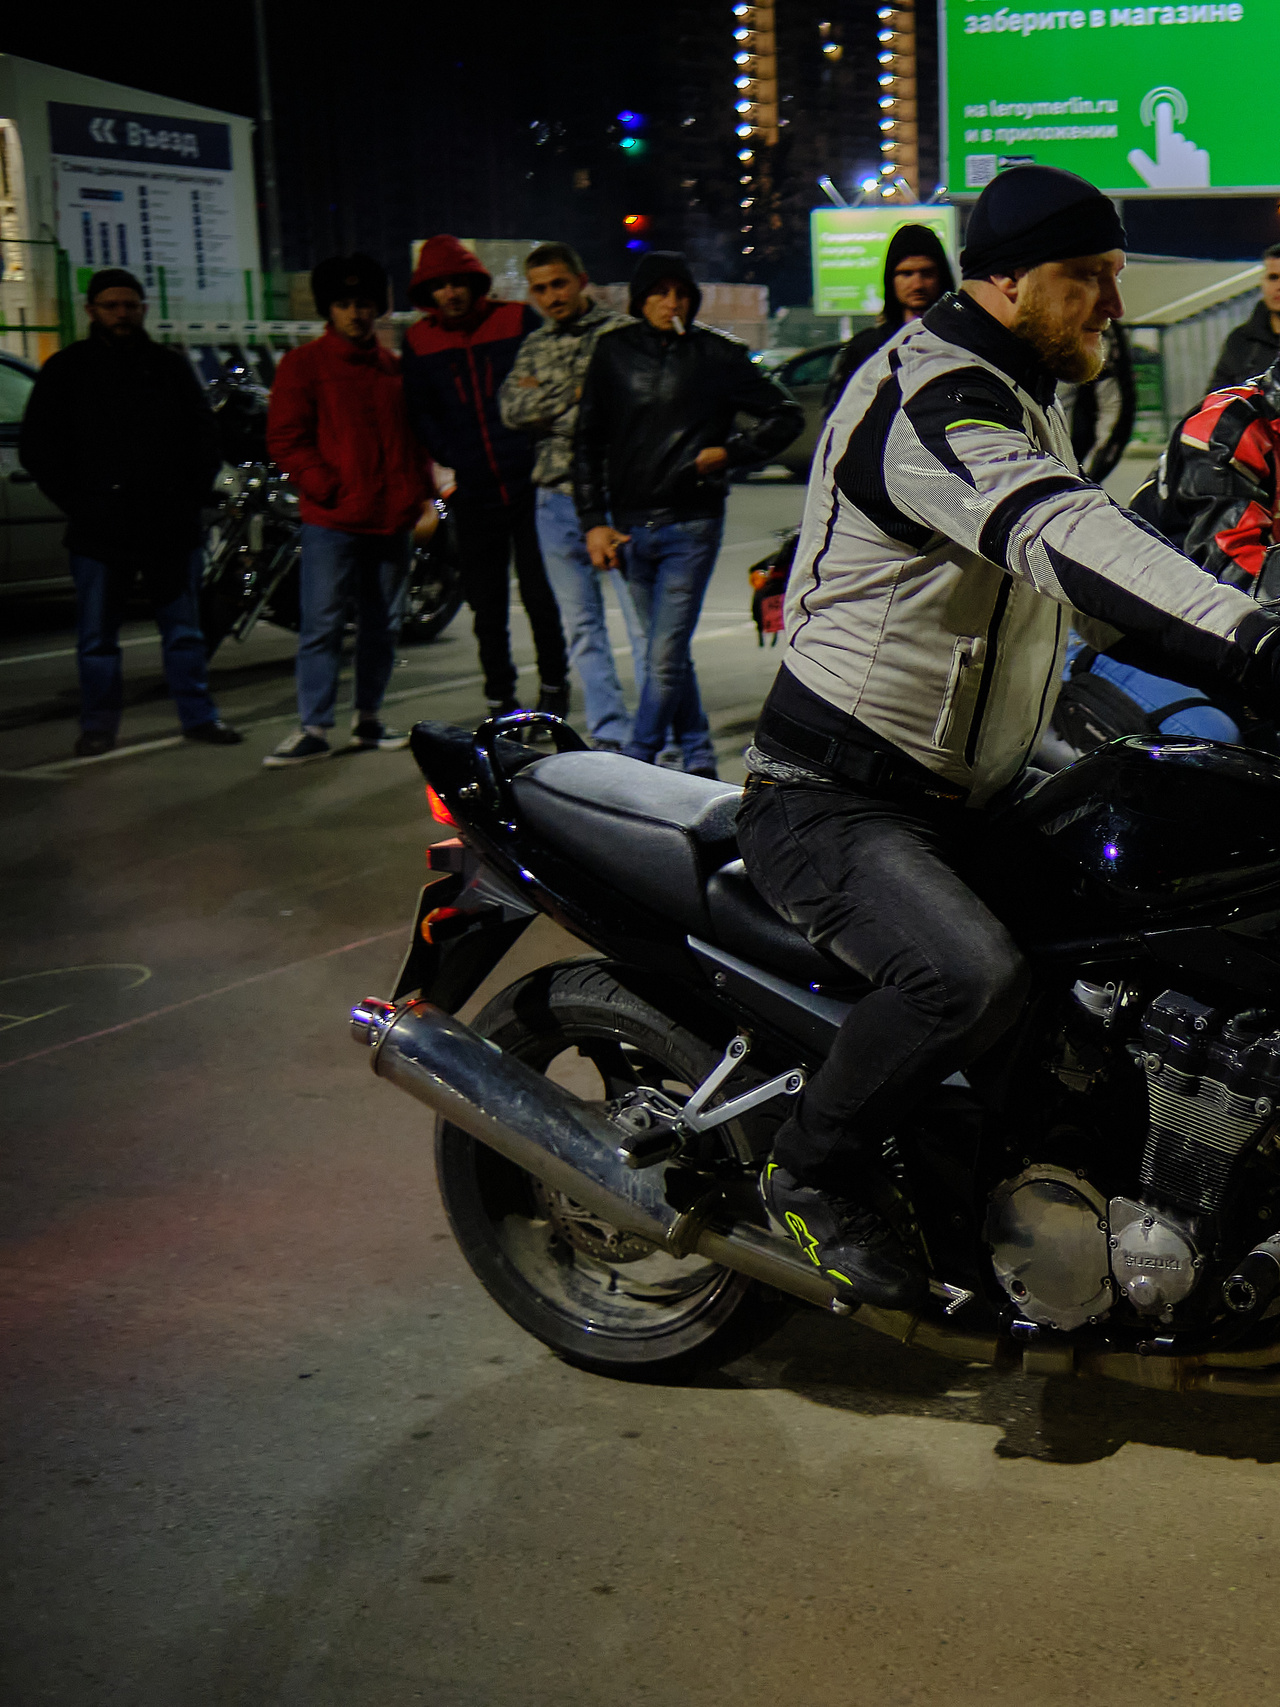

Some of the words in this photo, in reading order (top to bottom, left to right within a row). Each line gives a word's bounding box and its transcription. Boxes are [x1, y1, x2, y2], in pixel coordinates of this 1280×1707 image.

[964, 7, 1087, 37] заберите
[1089, 8, 1106, 28] в
[1110, 2, 1244, 27] магазине
[964, 103, 987, 118] на
[989, 96, 1118, 120] leroymerlin.ru
[124, 121, 201, 159] Въезд
[964, 128, 979, 143] и
[981, 128, 993, 143] в
[995, 124, 1118, 146] приложении
[1123, 1254, 1182, 1270] SUZUKI
